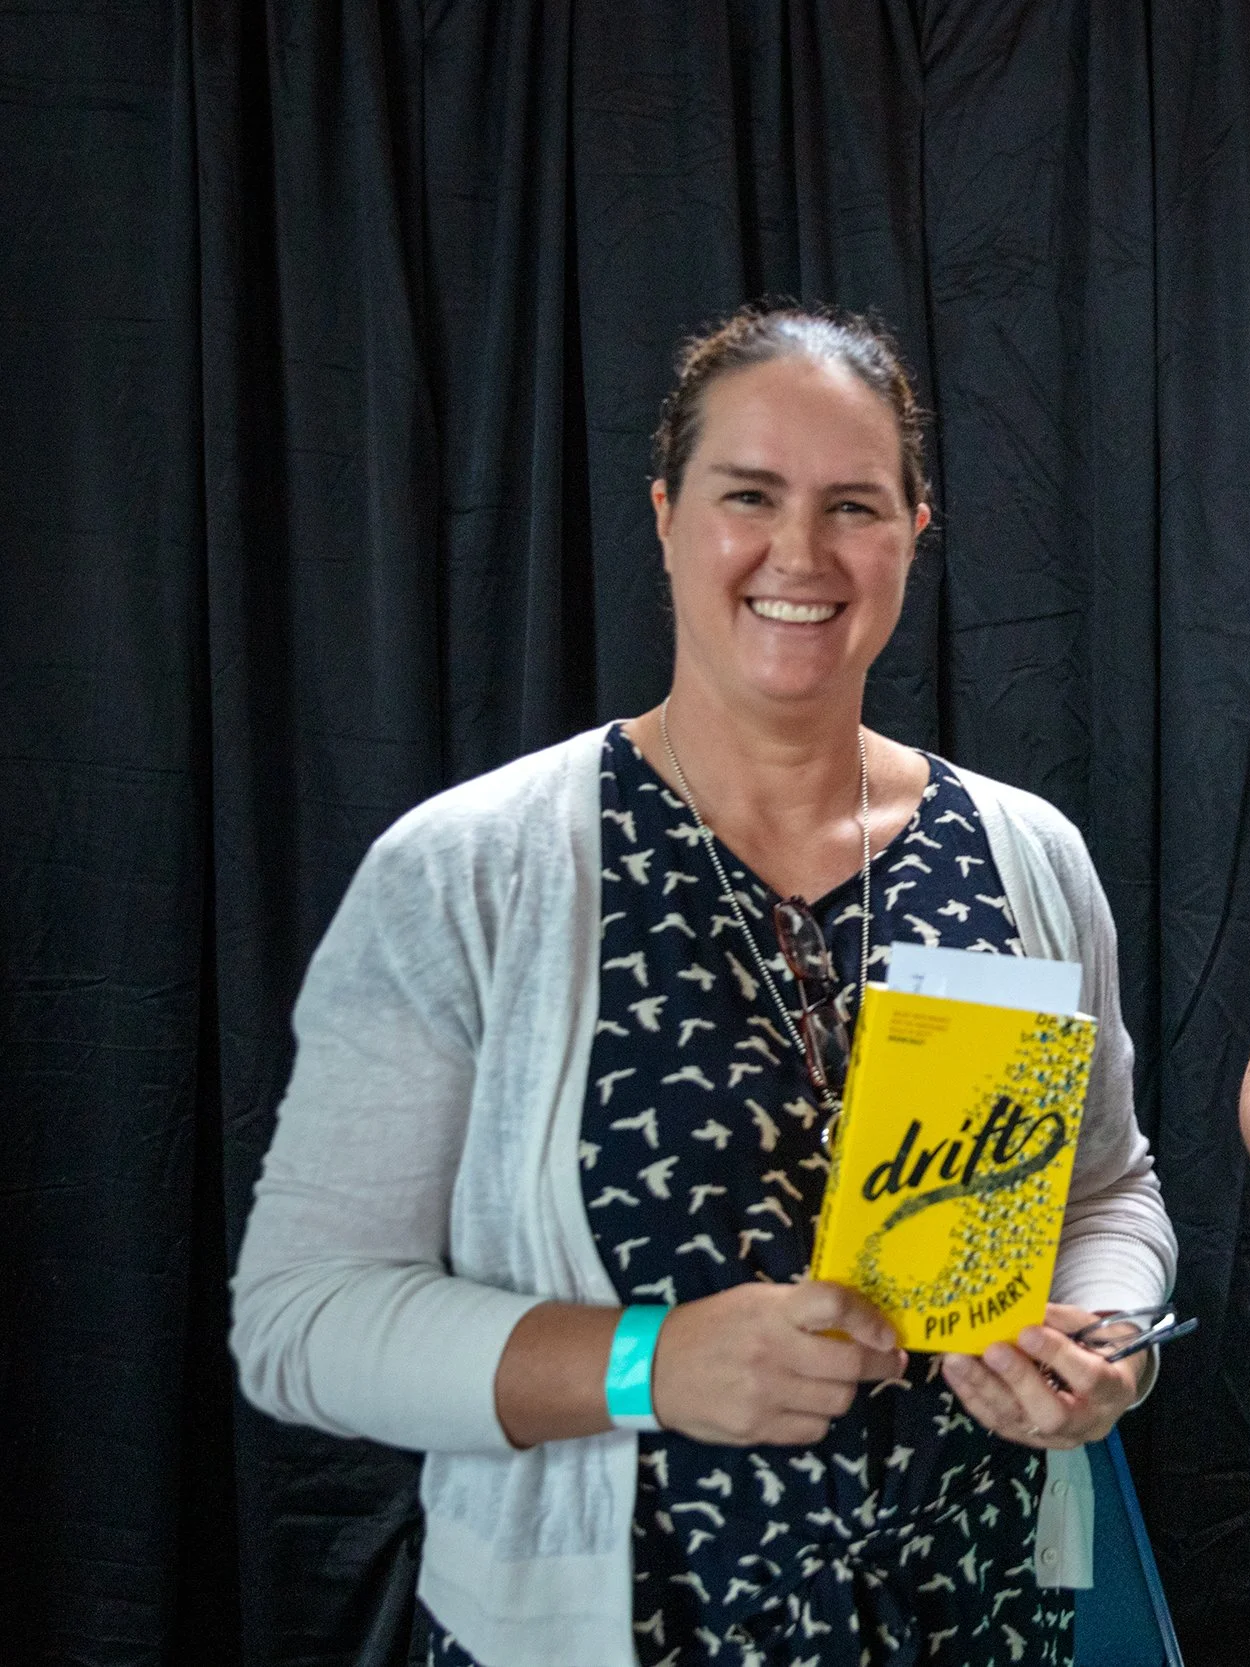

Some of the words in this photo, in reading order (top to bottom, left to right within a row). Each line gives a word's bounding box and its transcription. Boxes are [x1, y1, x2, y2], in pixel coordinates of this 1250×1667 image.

[862, 1094, 1066, 1203] drift
[925, 1311, 960, 1339] PIP
[969, 1271, 1031, 1329] HARRY
